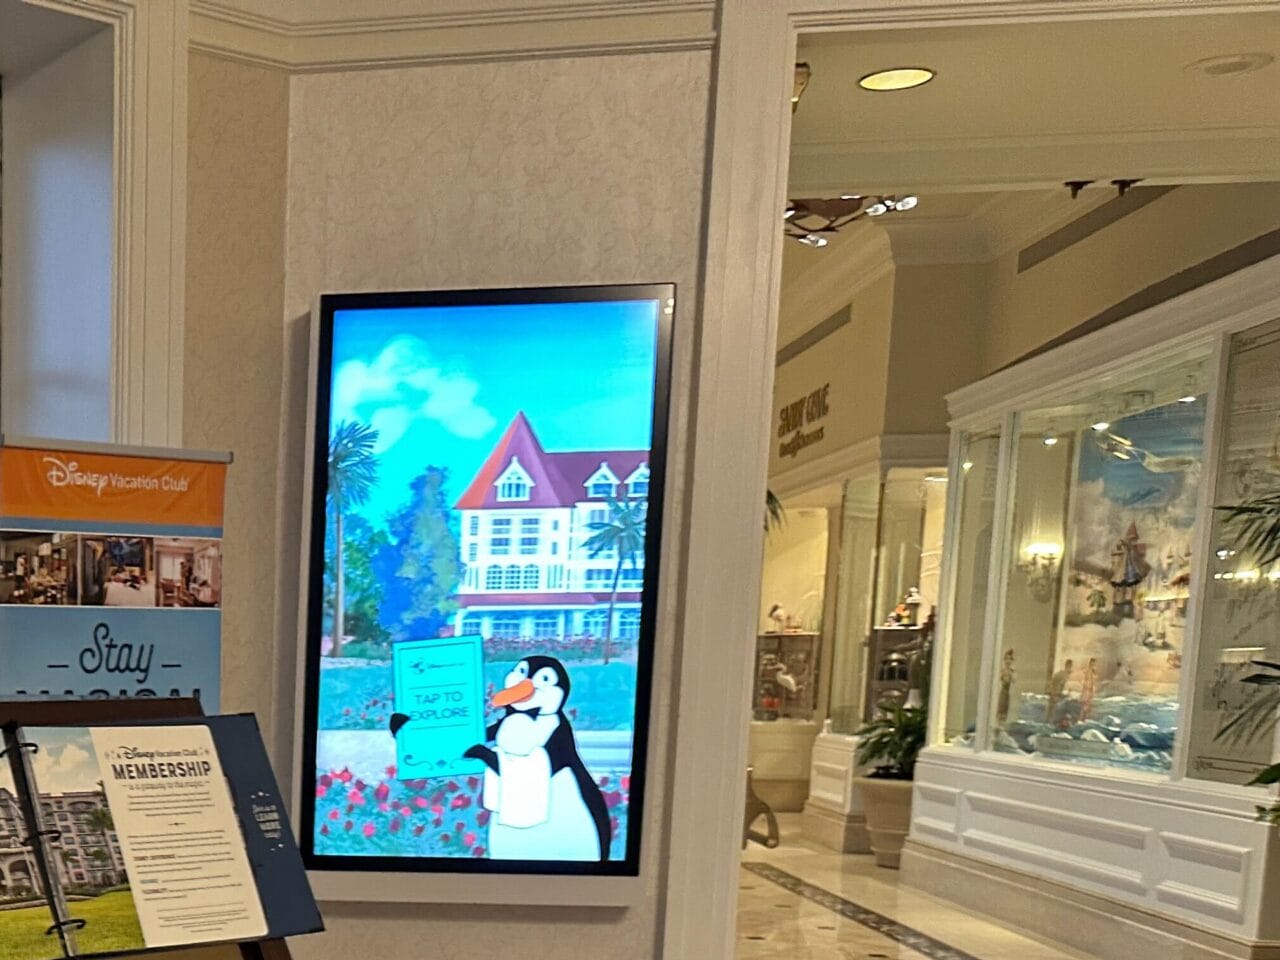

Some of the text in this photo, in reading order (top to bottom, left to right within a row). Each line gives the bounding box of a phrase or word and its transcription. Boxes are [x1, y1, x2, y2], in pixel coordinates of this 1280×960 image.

[43, 456, 188, 496] Disney Vacation Club
[79, 622, 154, 684] Stay
[414, 691, 464, 705] TAP TO
[410, 706, 470, 720] EXPLORE
[118, 746, 155, 761] Disney
[111, 761, 212, 780] MEMBERSHIP
